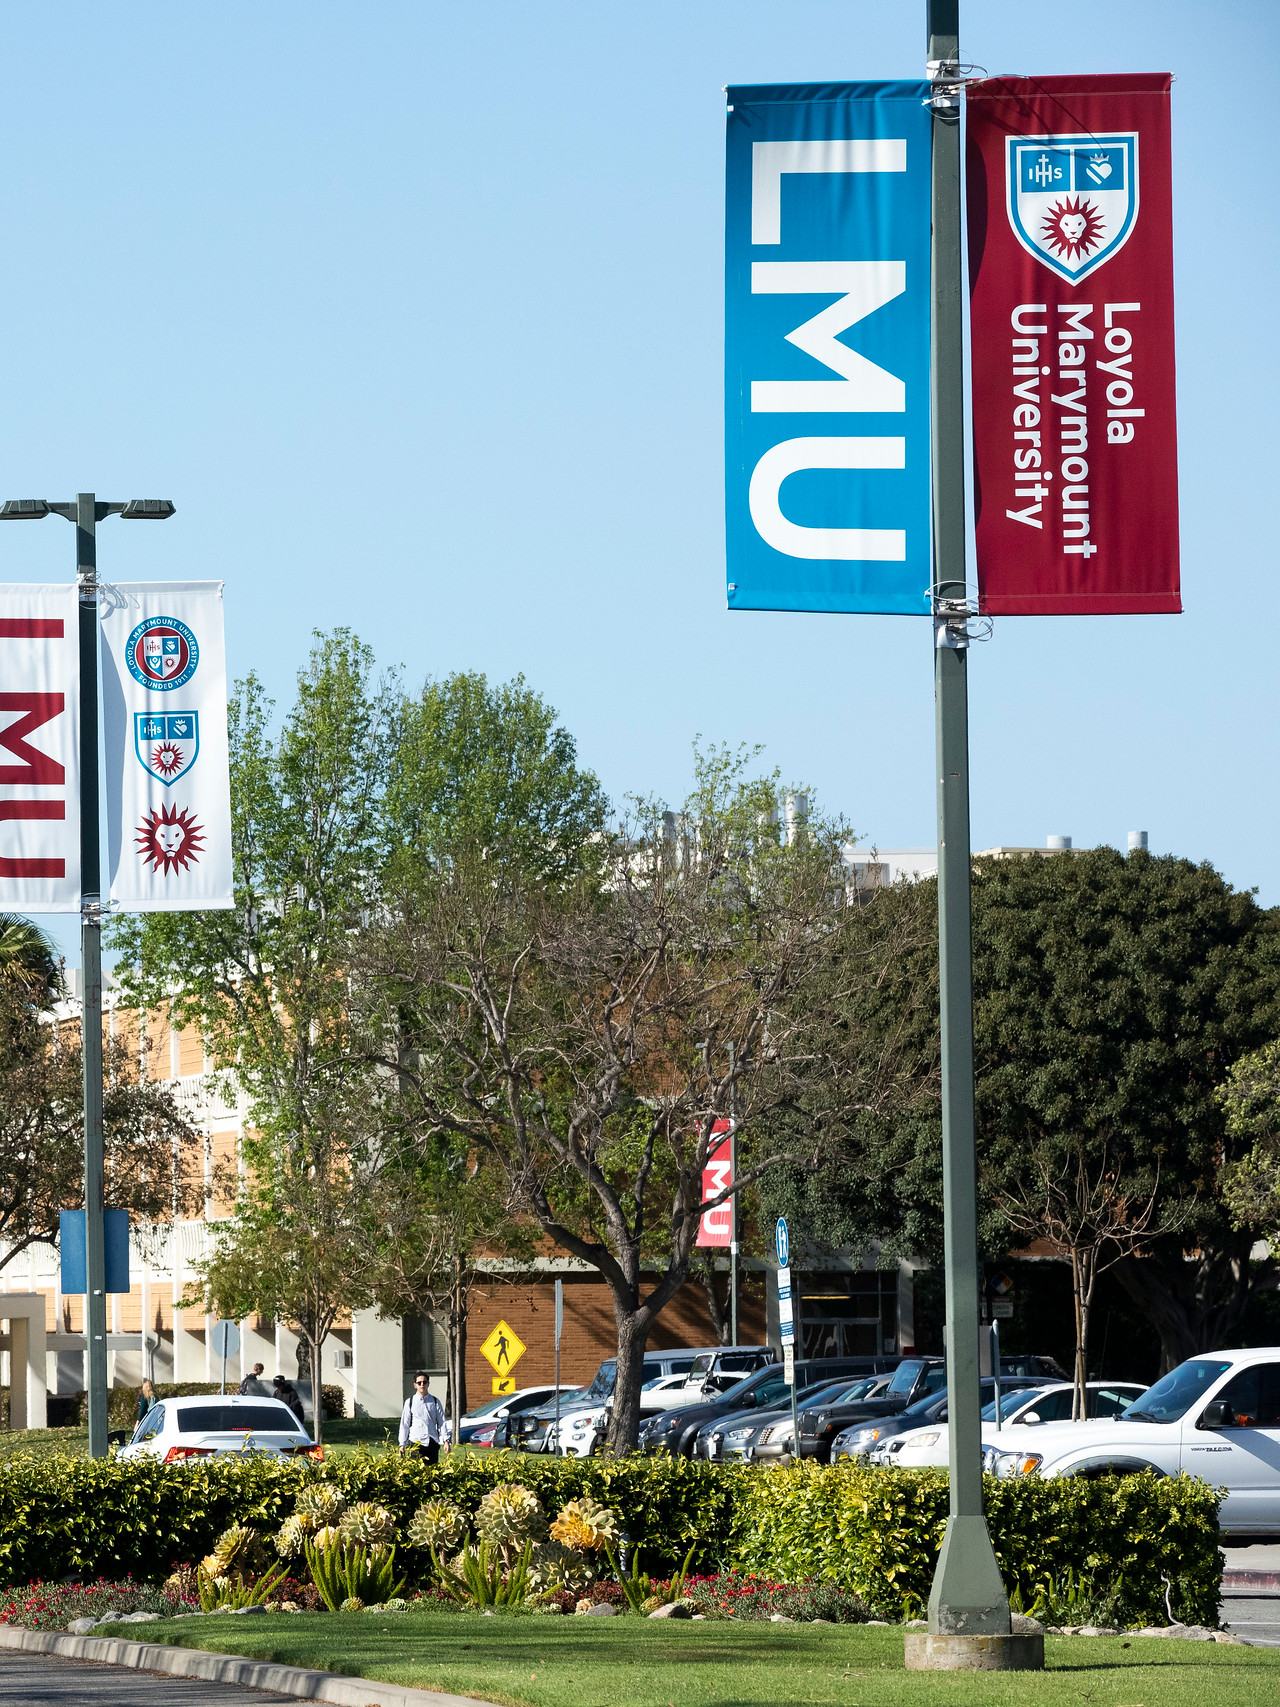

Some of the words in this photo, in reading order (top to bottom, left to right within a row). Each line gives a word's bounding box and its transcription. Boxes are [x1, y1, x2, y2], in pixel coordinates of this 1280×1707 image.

[748, 138, 907, 562] LMU
[1006, 303, 1053, 530] University
[1051, 303, 1097, 559] Marymount
[1096, 302, 1146, 445] Loyola
[127, 640, 136, 670] LOYOLA
[132, 618, 178, 639] MARYMOUNT
[179, 625, 198, 669] UNIVERSITY
[138, 675, 173, 690] FOUNDED
[174, 674, 189, 686] 1911
